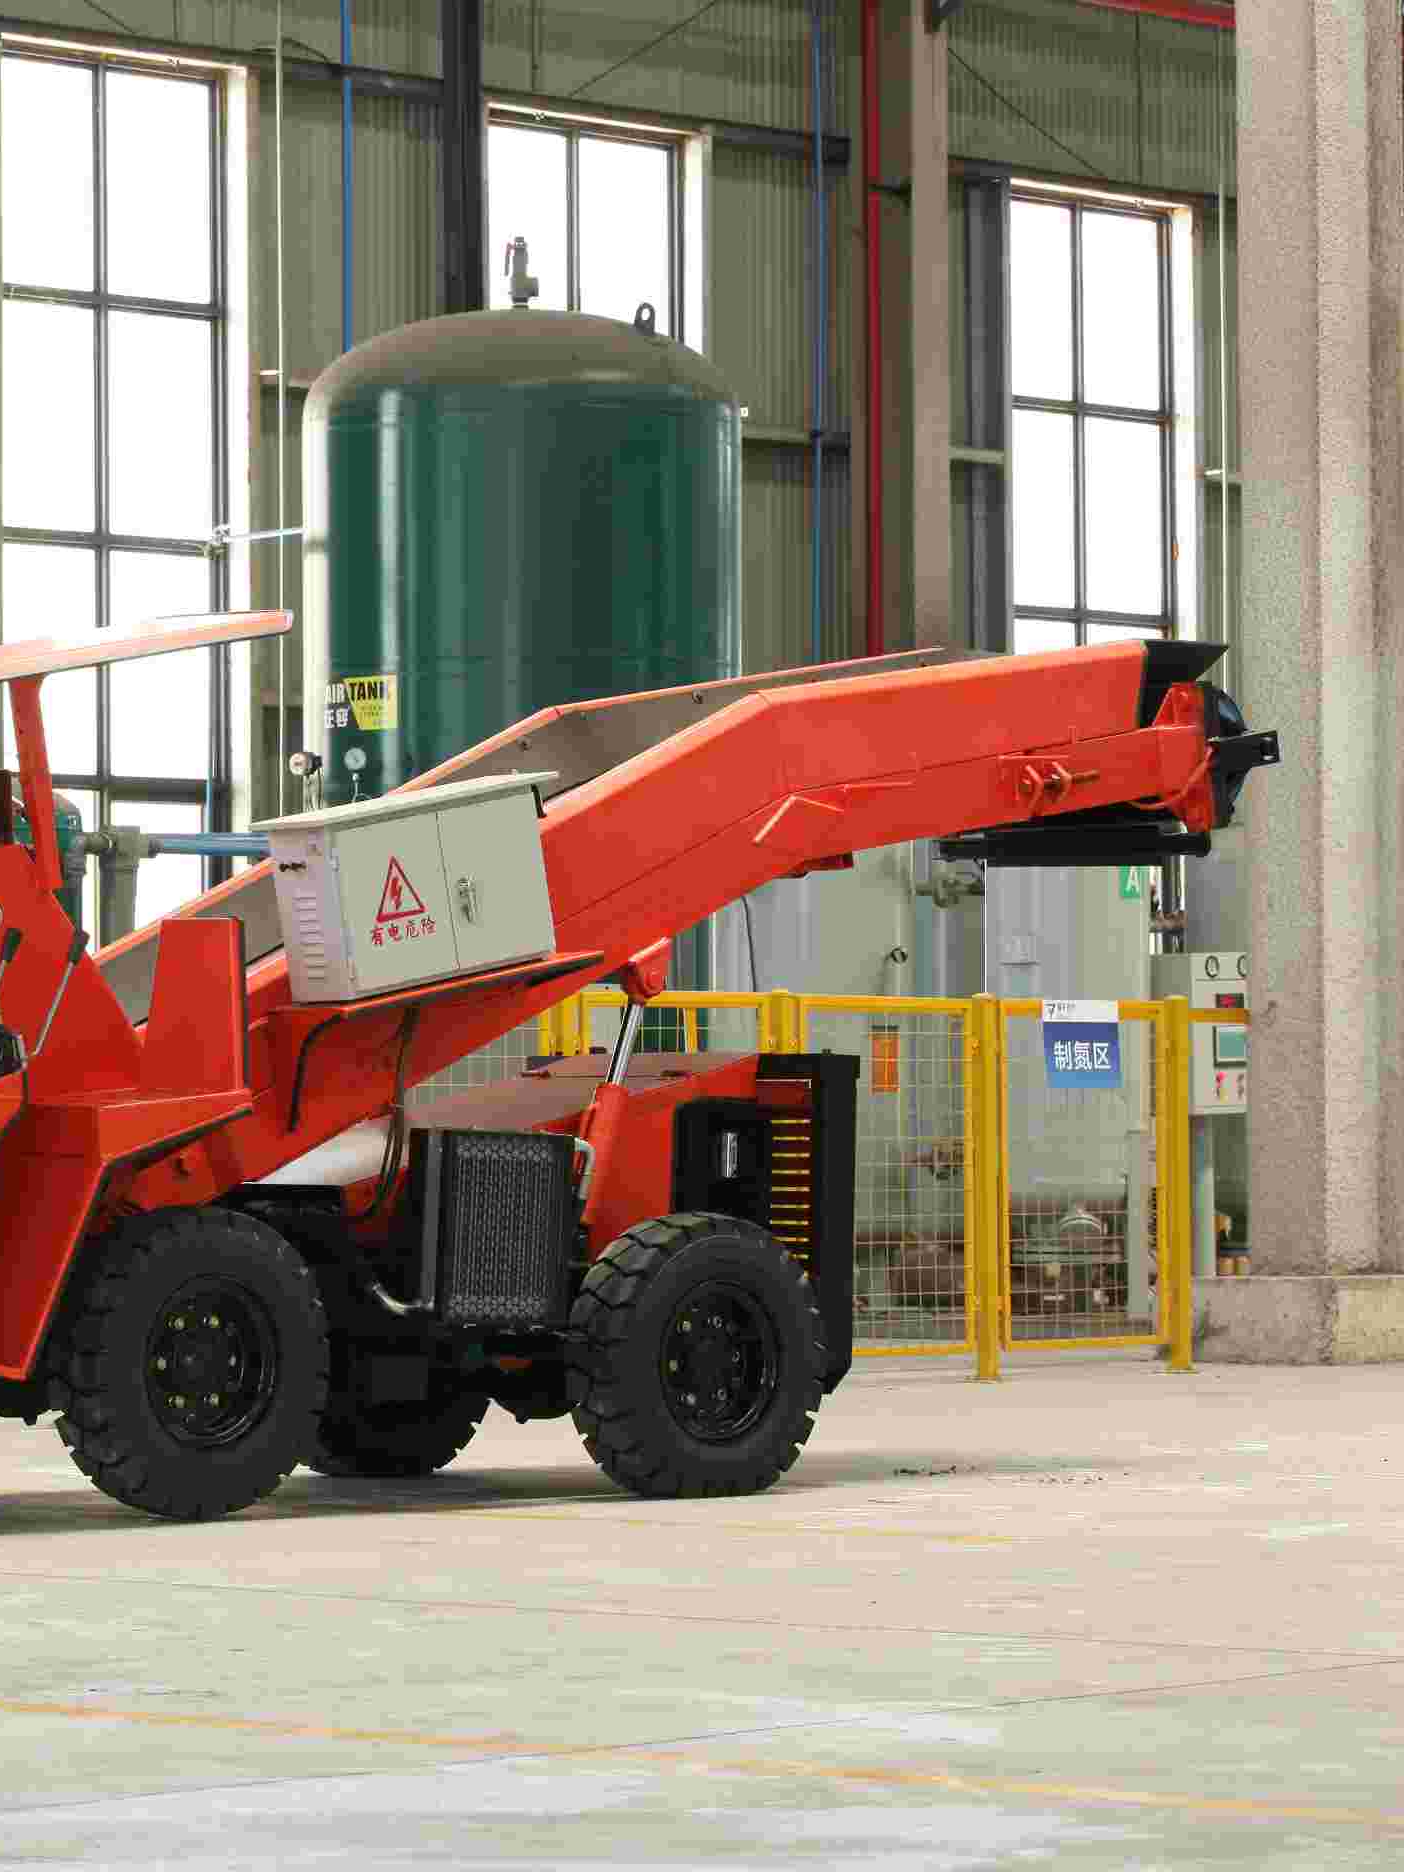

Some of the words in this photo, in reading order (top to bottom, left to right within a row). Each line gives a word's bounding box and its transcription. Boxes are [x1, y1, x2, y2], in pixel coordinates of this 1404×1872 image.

[372, 915, 436, 946] 有电危险
[1053, 1040, 1112, 1071] 制氮区
